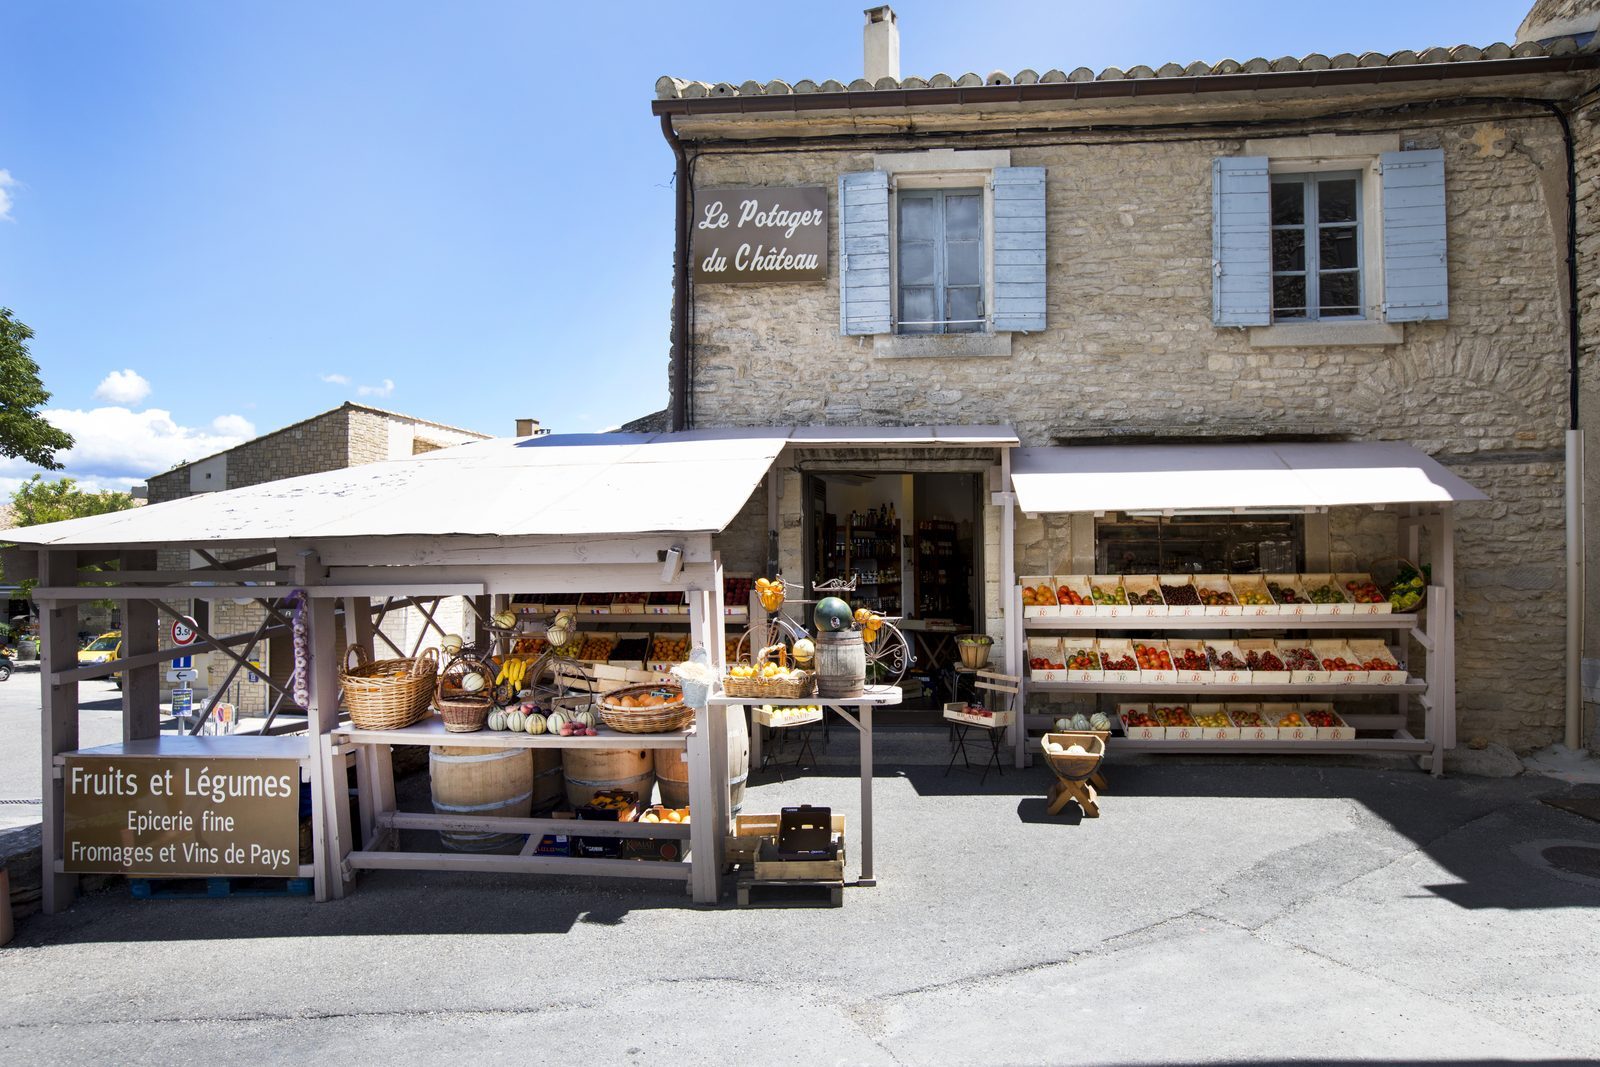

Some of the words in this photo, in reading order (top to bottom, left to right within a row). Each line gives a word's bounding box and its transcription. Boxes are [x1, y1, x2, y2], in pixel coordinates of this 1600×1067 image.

[698, 201, 729, 229] Le
[737, 200, 823, 238] Potager
[702, 248, 727, 272] du
[735, 243, 819, 271] Château
[72, 767, 138, 796] Fruits
[150, 769, 173, 796] et
[185, 767, 292, 803] Légumes
[128, 810, 193, 835] Epicerie
[202, 811, 234, 832] fine
[72, 842, 153, 866] Fromages
[160, 844, 176, 863] et
[183, 843, 219, 863] Vins
[225, 843, 245, 864] de
[251, 844, 291, 869] Pays
